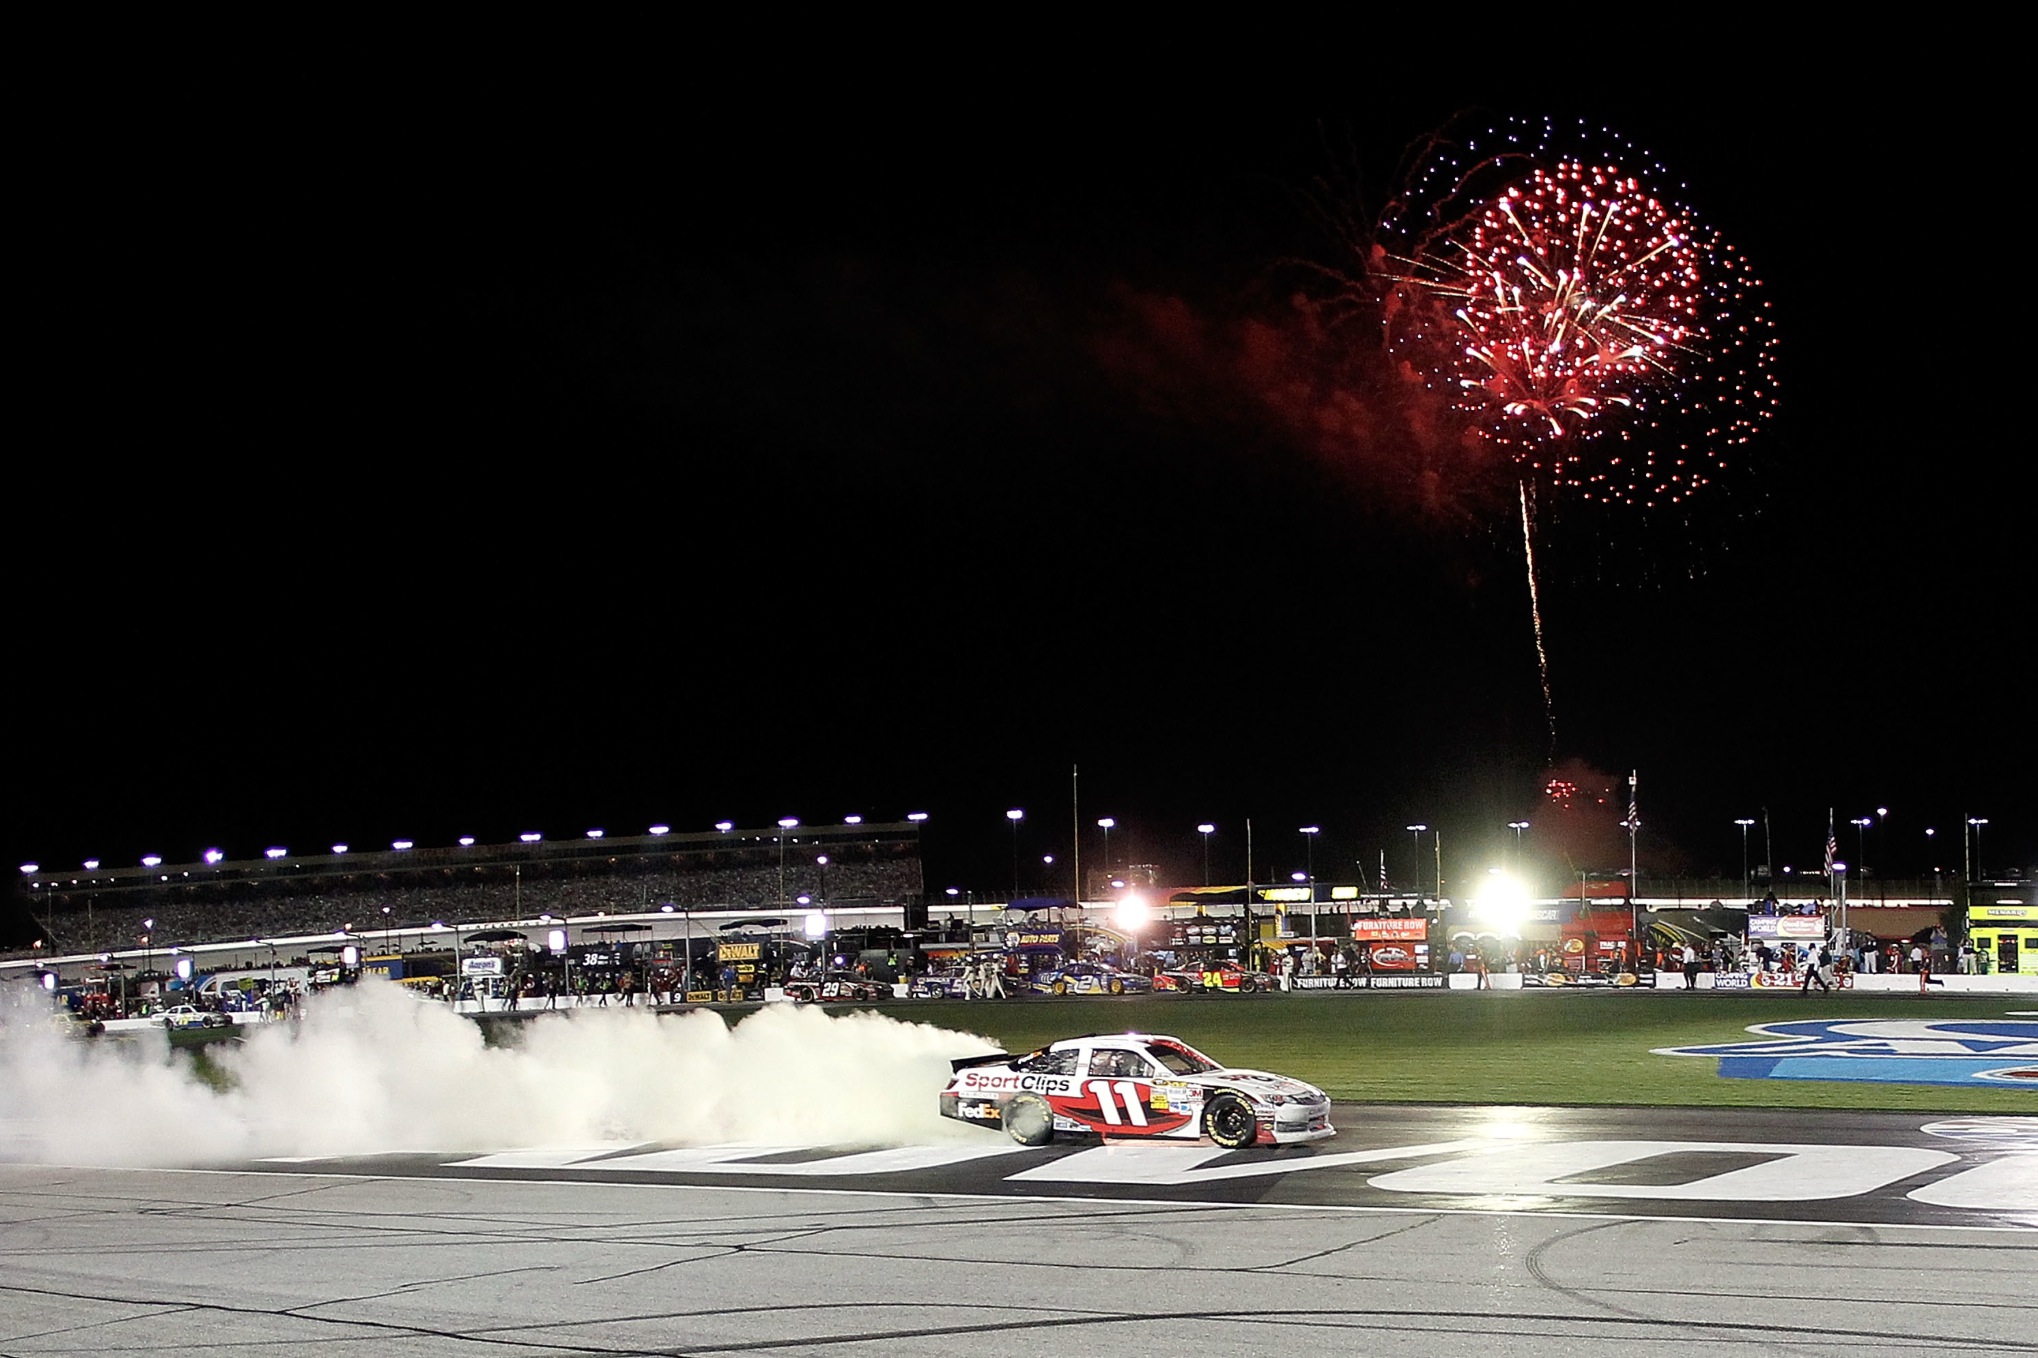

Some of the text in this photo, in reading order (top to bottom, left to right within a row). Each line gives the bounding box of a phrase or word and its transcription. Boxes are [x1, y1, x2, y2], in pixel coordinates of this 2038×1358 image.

[1358, 921, 1424, 930] FURNITURE ROW
[1020, 934, 1038, 944] AUTO
[718, 944, 760, 959] DEWALT
[583, 953, 598, 966] 38
[1077, 975, 1092, 990] 2
[1202, 972, 1223, 988] 24
[1298, 977, 1345, 988] FURNITUE
[1371, 977, 1443, 988] FURNITURE ROW
[1715, 979, 1748, 988] WORLD
[1774, 973, 1794, 986] 21
[822, 981, 840, 997] 29
[673, 992, 682, 1002] 9
[1188, 1088, 1202, 1099] 3M
[1088, 1079, 1148, 1127] 11
[957, 1101, 1001, 1119] FedEx
